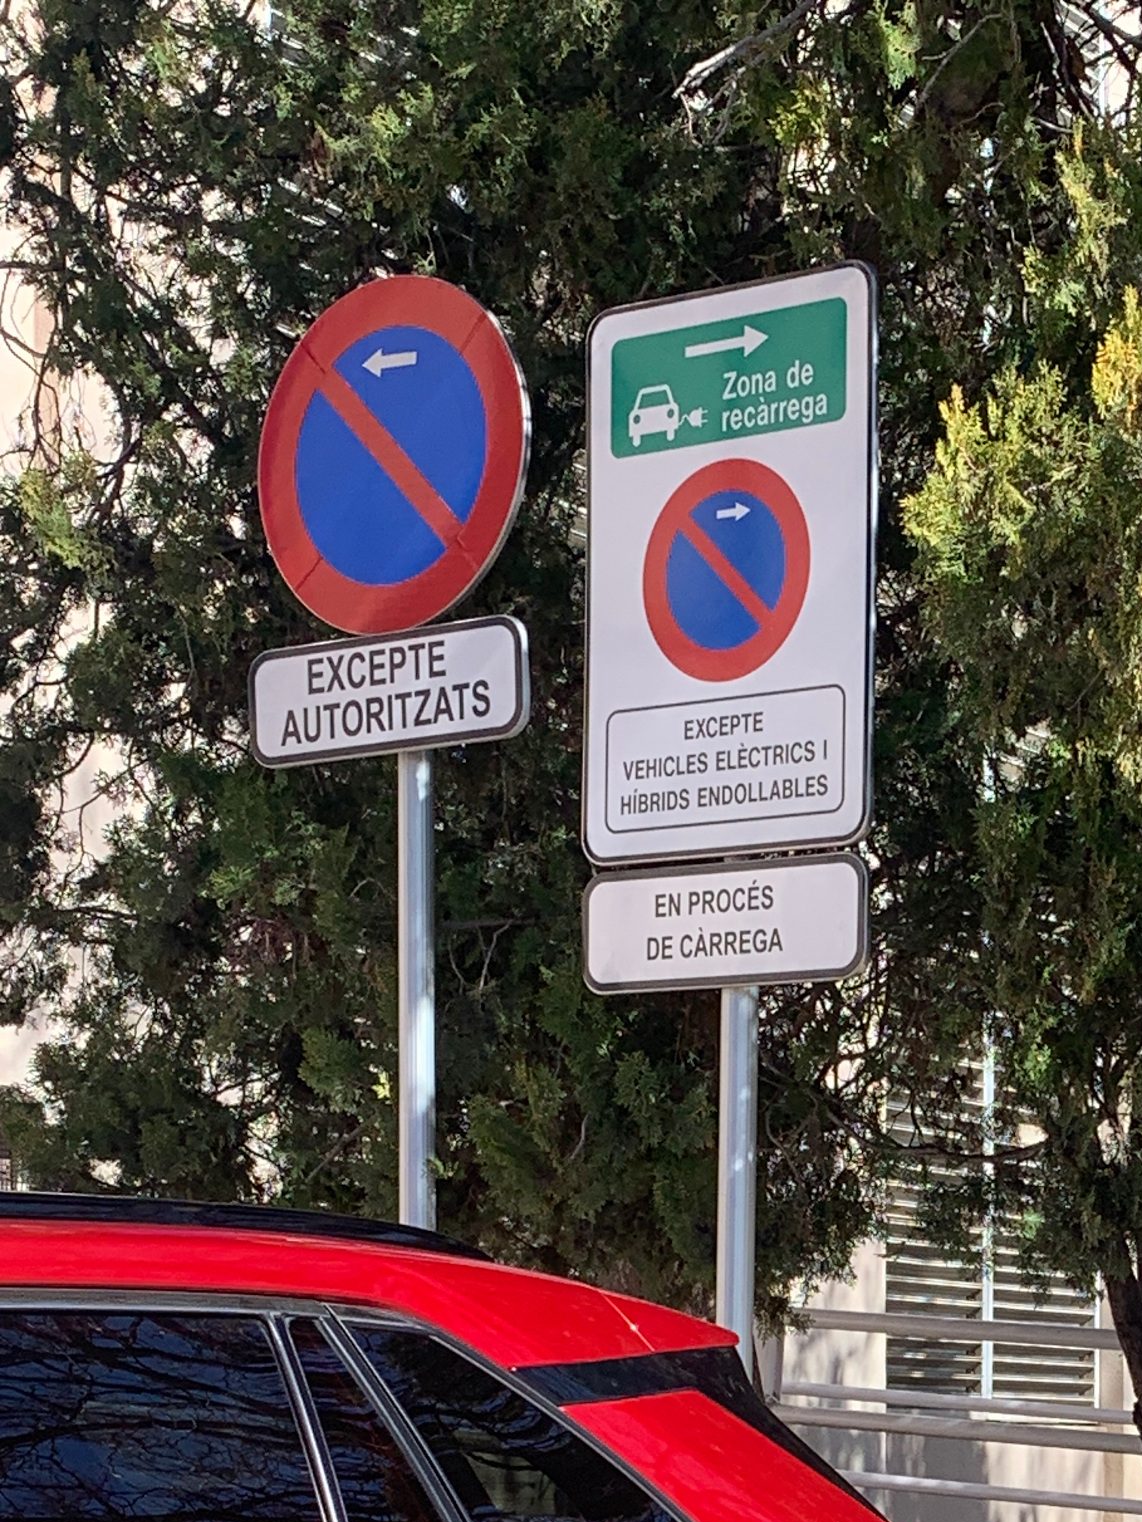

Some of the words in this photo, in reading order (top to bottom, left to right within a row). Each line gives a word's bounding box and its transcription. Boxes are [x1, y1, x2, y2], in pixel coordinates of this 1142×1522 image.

[721, 370, 777, 401] Zona
[786, 359, 815, 389] de
[721, 393, 828, 433] recàrrega
[307, 639, 447, 696] EXCEPTE
[280, 679, 491, 747] AUTORITZATS
[683, 711, 765, 741] EXCEPTE
[623, 751, 709, 782] VEHICLES
[715, 742, 816, 772] ELÈCTRICS
[823, 739, 828, 761] I
[620, 788, 690, 816] HÍBRIDS
[696, 773, 829, 808] ENDOLLABLES
[654, 892, 682, 918] EN
[687, 879, 775, 916] PROCÉS
[646, 935, 674, 961] DE
[679, 926, 784, 959] CÀRREGA
